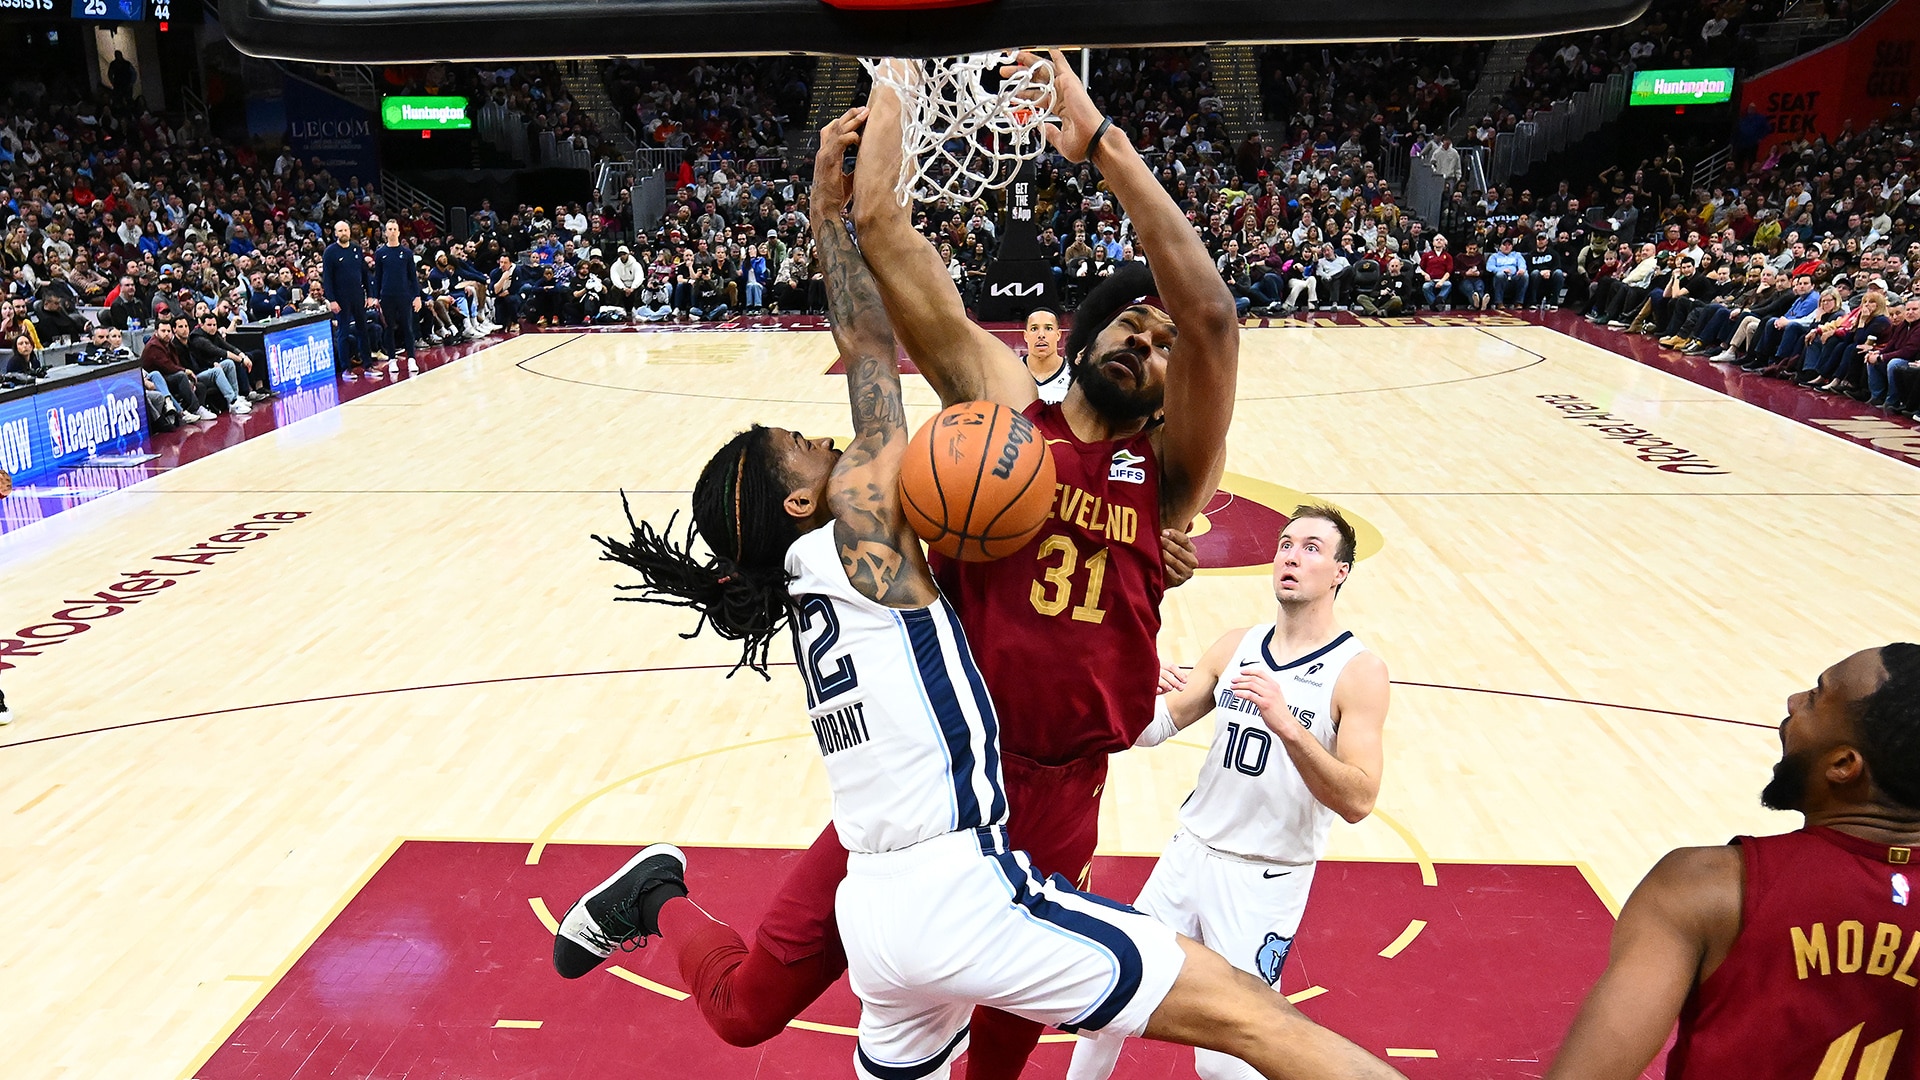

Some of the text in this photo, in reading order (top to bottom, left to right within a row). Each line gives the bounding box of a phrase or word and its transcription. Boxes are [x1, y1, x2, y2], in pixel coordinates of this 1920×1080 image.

[154, 5, 170, 20] 44
[1654, 78, 1725, 98] Huntington
[1767, 91, 1820, 112] SEAT
[402, 104, 464, 124] Huntington
[1015, 182, 1029, 194] GET
[1015, 194, 1029, 206] THE
[1018, 206, 1031, 221] App
[990, 282, 1044, 296] KIA
[277, 335, 331, 386] League Pass
[59, 393, 140, 455] League Pass
[1109, 469, 1143, 481] LIFFS
[152, 511, 312, 565] Arena
[1029, 534, 1109, 624] 31
[1294, 674, 1323, 688] Robinhood
[811, 702, 870, 757] MORANT
[1222, 721, 1272, 777] 10
